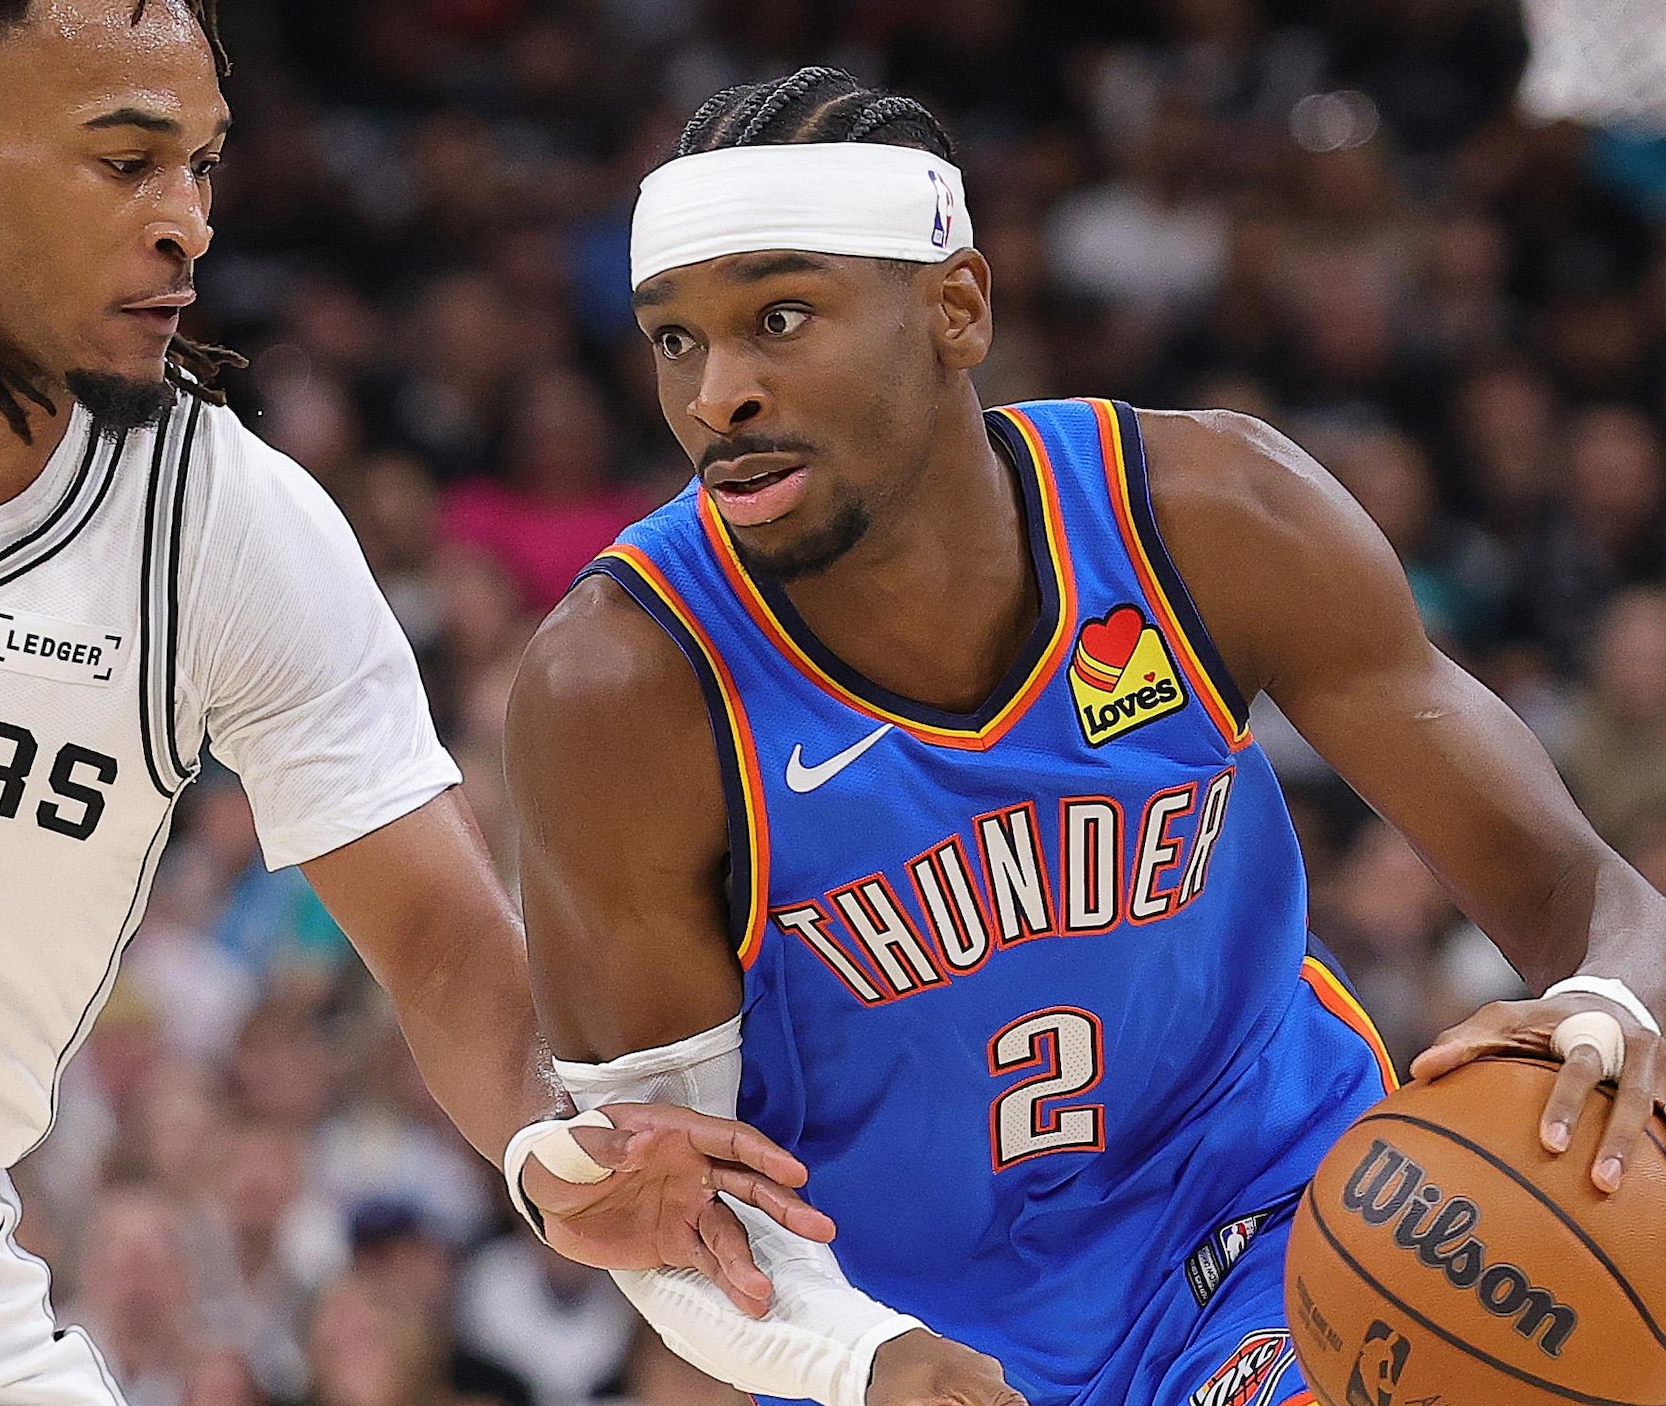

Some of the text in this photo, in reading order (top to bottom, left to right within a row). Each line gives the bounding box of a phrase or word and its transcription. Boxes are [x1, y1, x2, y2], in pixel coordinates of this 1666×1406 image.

[6, 629, 102, 666] LEDGER
[769, 765, 1236, 1007] THUNDER
[987, 1006, 1105, 1173] 2
[1340, 1138, 1579, 1359] Wilson
